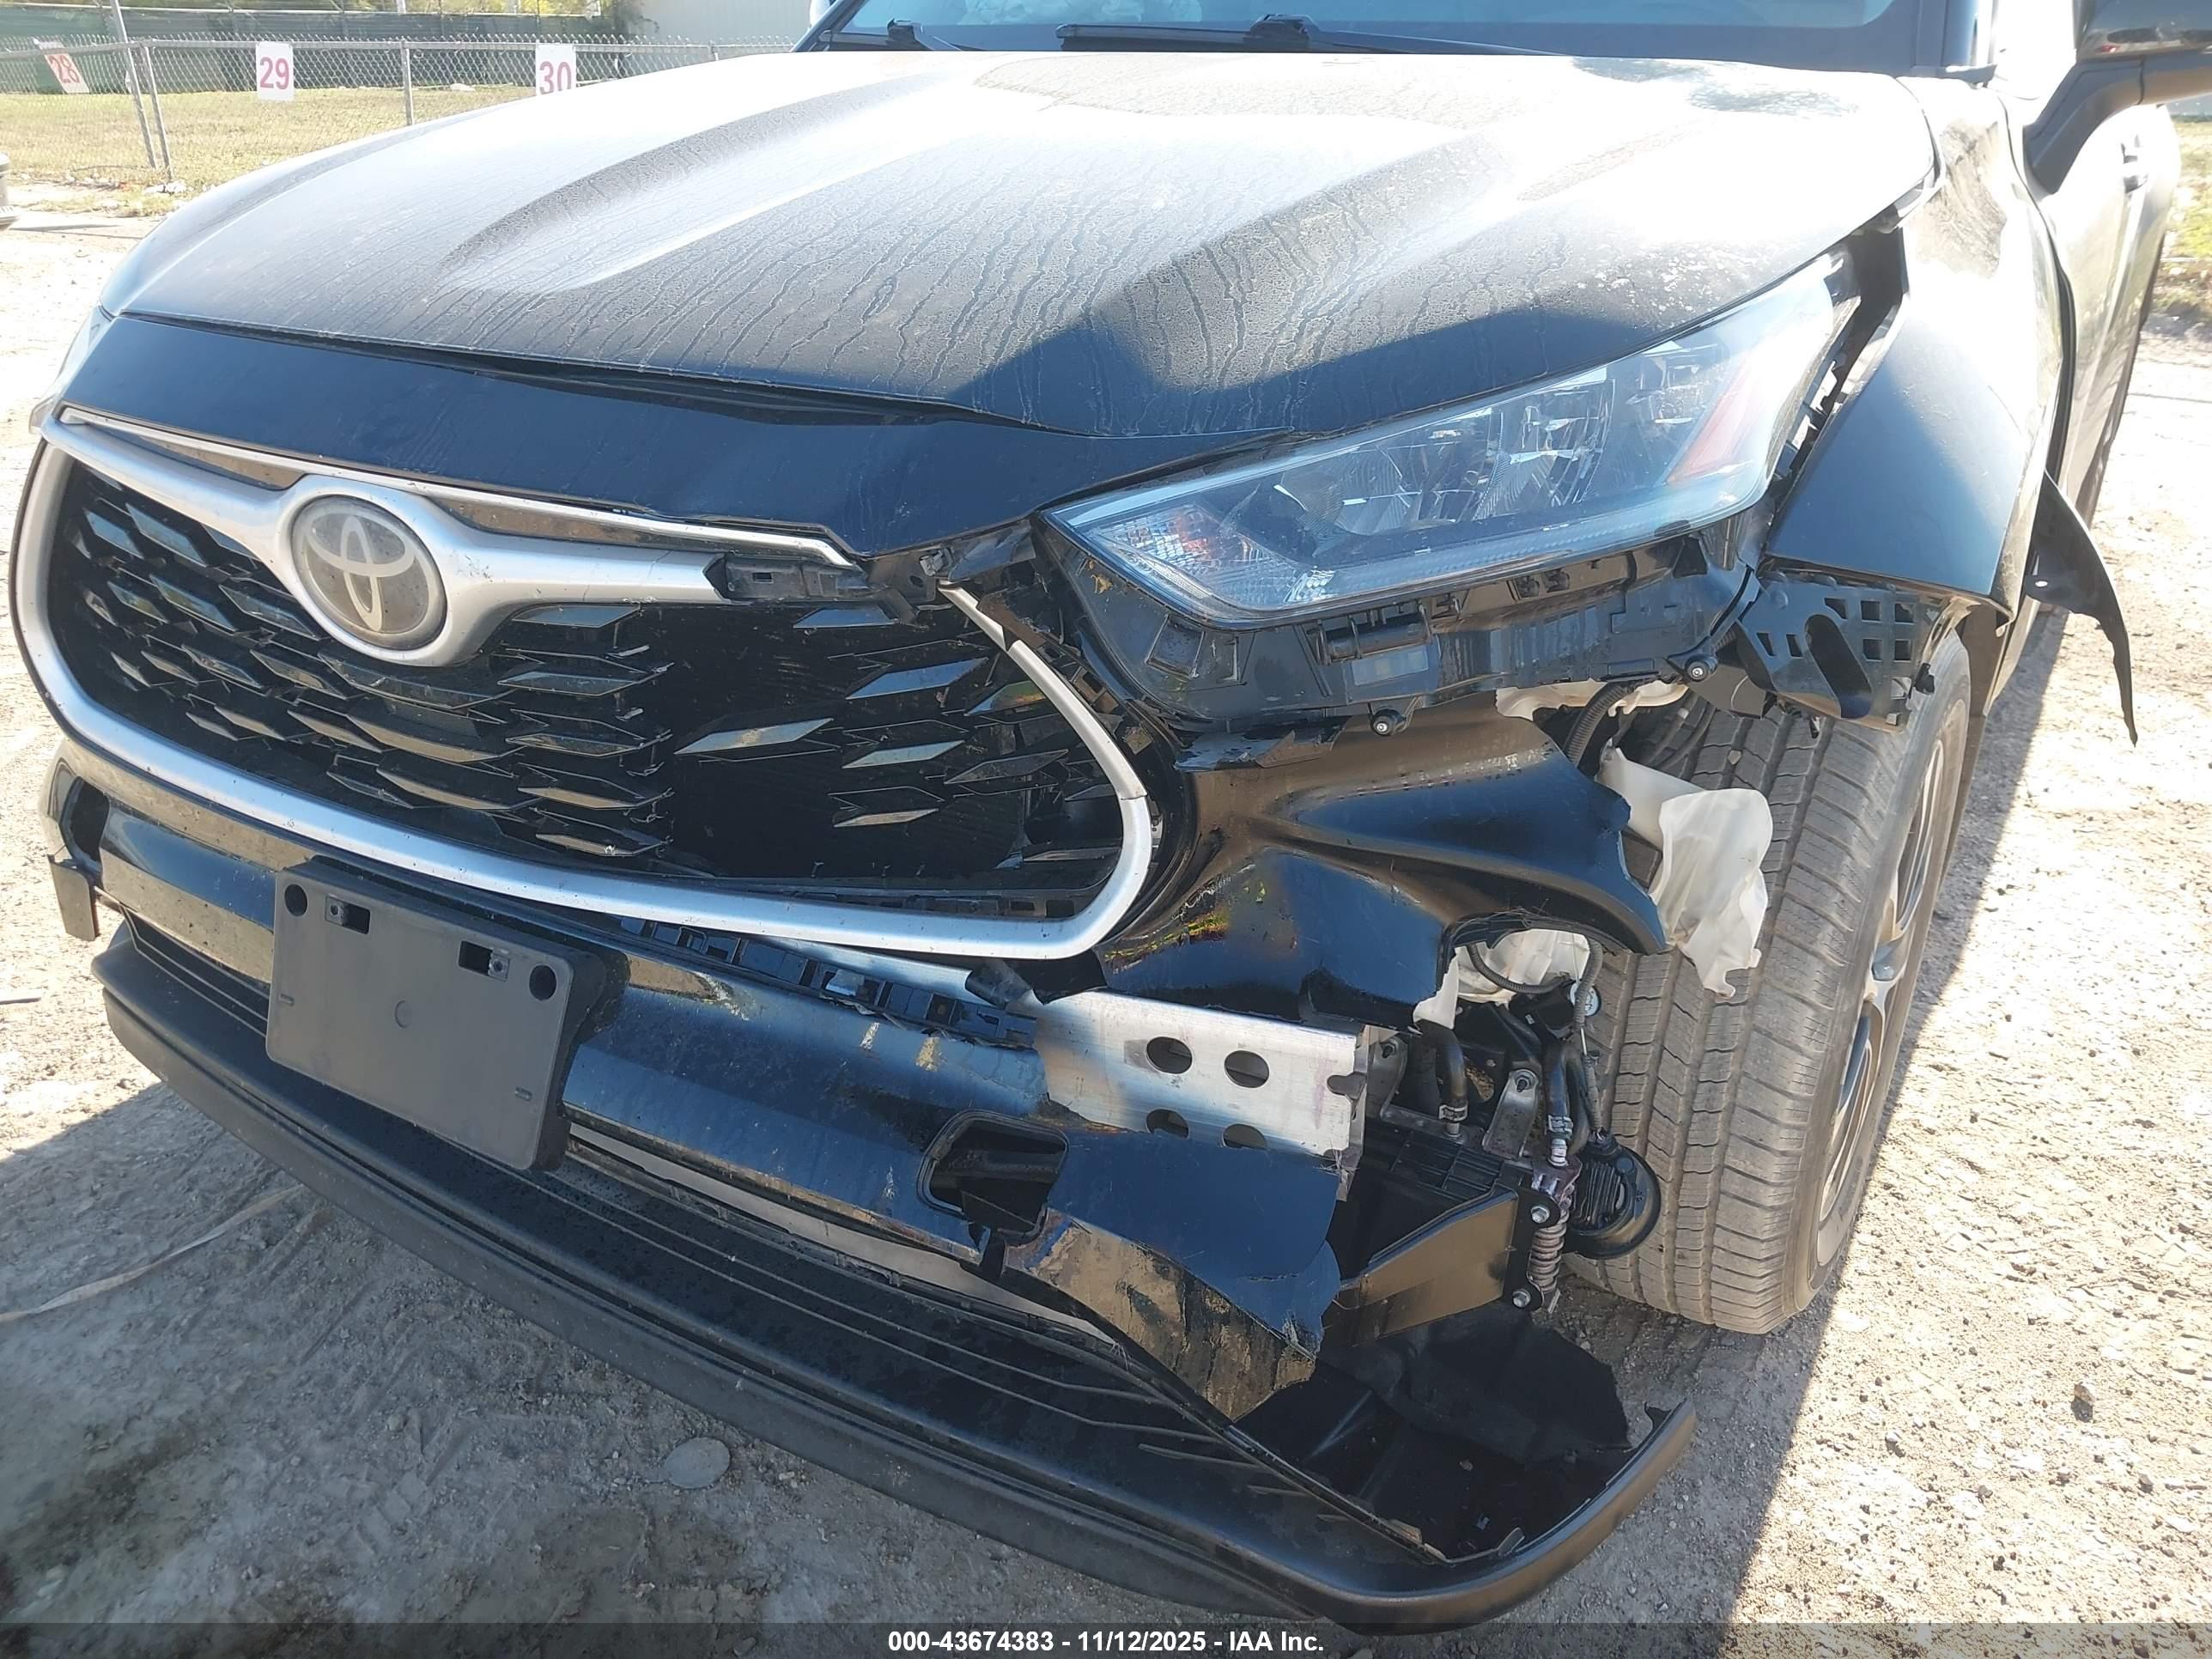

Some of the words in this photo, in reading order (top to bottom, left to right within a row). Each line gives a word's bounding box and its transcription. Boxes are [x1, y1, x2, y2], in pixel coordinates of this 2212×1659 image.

[48, 55, 80, 83] 28
[259, 57, 289, 90] 29
[539, 61, 572, 95] 30
